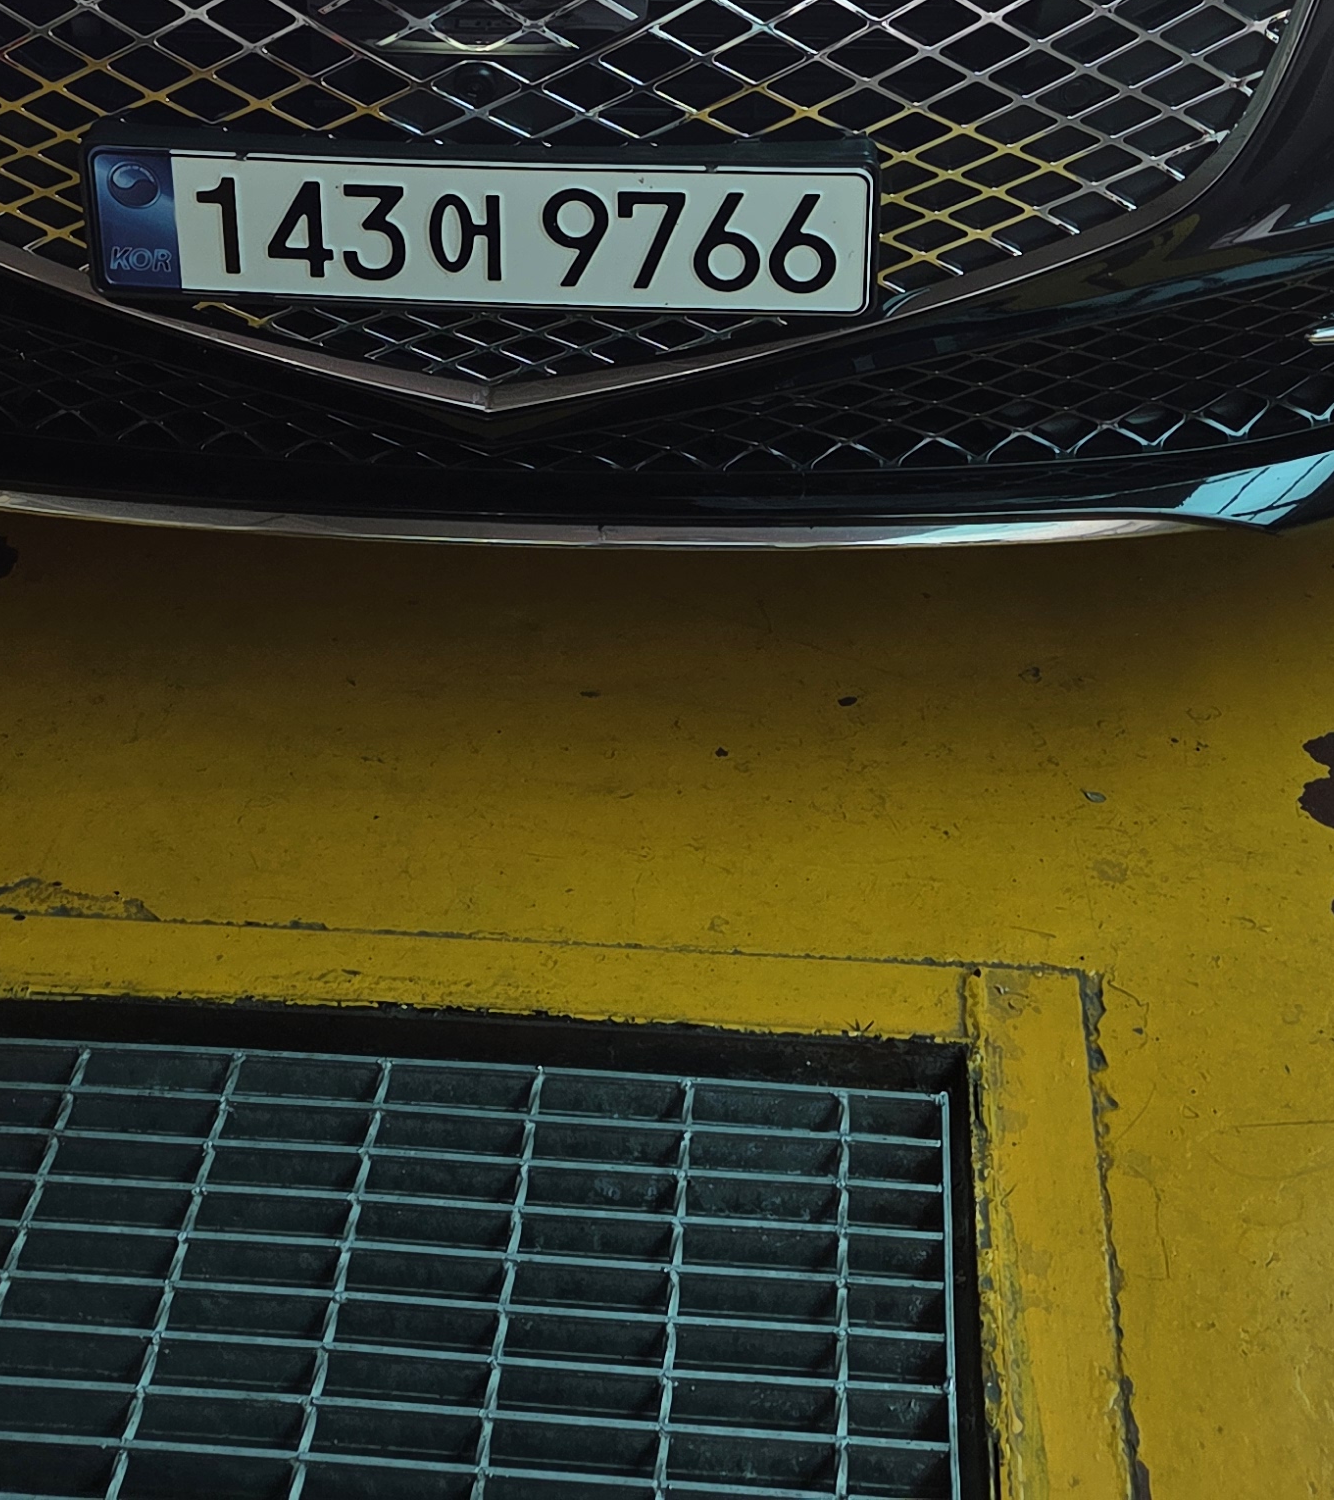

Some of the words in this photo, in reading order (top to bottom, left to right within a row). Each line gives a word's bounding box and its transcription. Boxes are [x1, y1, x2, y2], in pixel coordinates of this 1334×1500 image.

[110, 246, 172, 272] KOR
[194, 176, 503, 283] 143어
[541, 187, 838, 294] 9766
